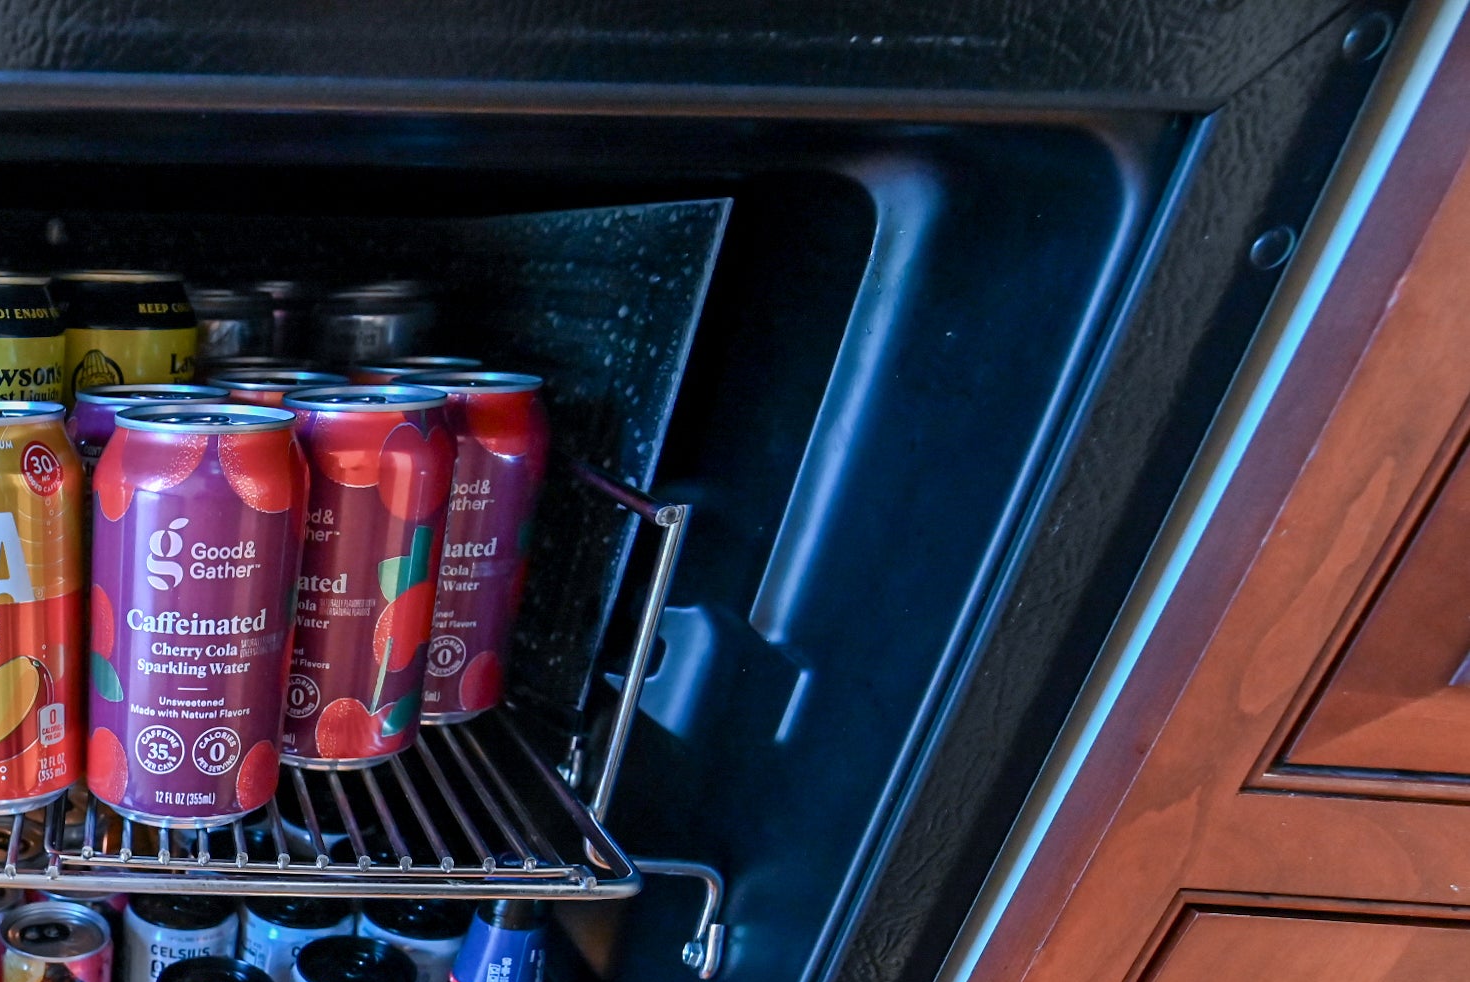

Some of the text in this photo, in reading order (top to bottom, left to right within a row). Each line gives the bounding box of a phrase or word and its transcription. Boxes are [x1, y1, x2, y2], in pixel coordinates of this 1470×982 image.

[138, 303, 168, 314] KEEP
[31, 455, 52, 474] 30
[443, 581, 479, 592] Water
[127, 608, 266, 636] Caffeinated
[151, 643, 202, 660] Cherry
[205, 644, 237, 657] Cola
[438, 649, 452, 665] 0
[137, 658, 250, 678] Sparkling Water
[300, 659, 330, 669] Flavors
[159, 697, 225, 707] Unsweetened
[292, 688, 304, 705] 0
[49, 709, 57, 723] 0
[131, 704, 250, 719] Made with Natural Flavors
[140, 729, 179, 749] CAFFEINE
[199, 731, 236, 749] CALORIES
[148, 742, 169, 760] 35
[209, 742, 225, 762] 0
[144, 758, 174, 772] PER CAN
[197, 754, 236, 773] PER SERVING
[156, 791, 216, 807] 12 FL OZ (355mL)
[151, 944, 210, 958] CELSIUS
